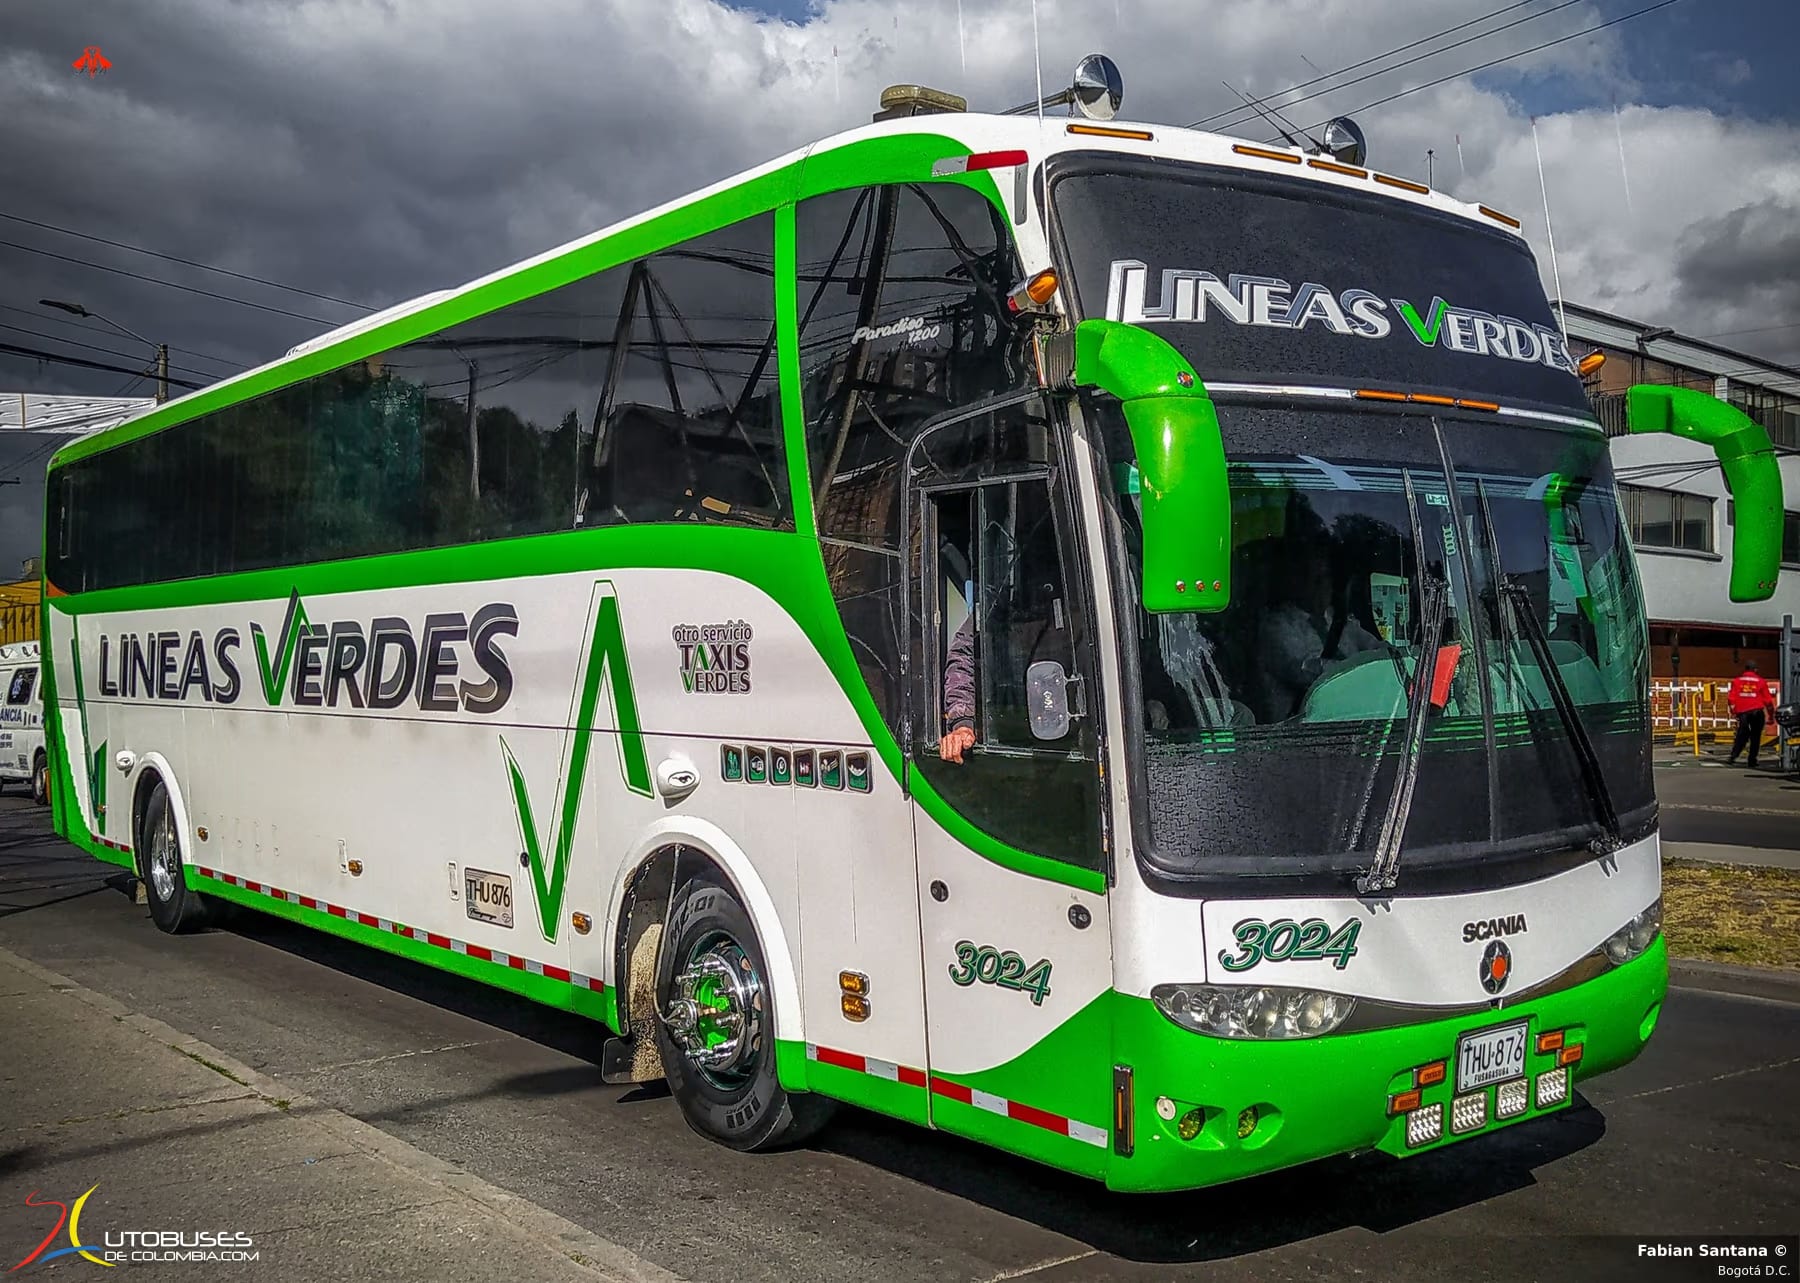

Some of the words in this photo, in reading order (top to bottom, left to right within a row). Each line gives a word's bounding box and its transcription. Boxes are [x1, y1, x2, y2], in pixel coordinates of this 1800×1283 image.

[1106, 260, 1391, 338] LINEAS
[851, 317, 924, 345] Paradiso
[908, 325, 940, 344] 1200
[674, 627, 699, 642] otro
[703, 623, 752, 641] servicio
[100, 627, 241, 704] LINEAS
[249, 585, 520, 714] VERDES
[680, 644, 750, 671] TAXIS
[682, 671, 751, 692] VERDES
[1462, 914, 1527, 943] SCANIA
[1220, 917, 1362, 972] 3024
[949, 940, 1054, 1006] 3024
